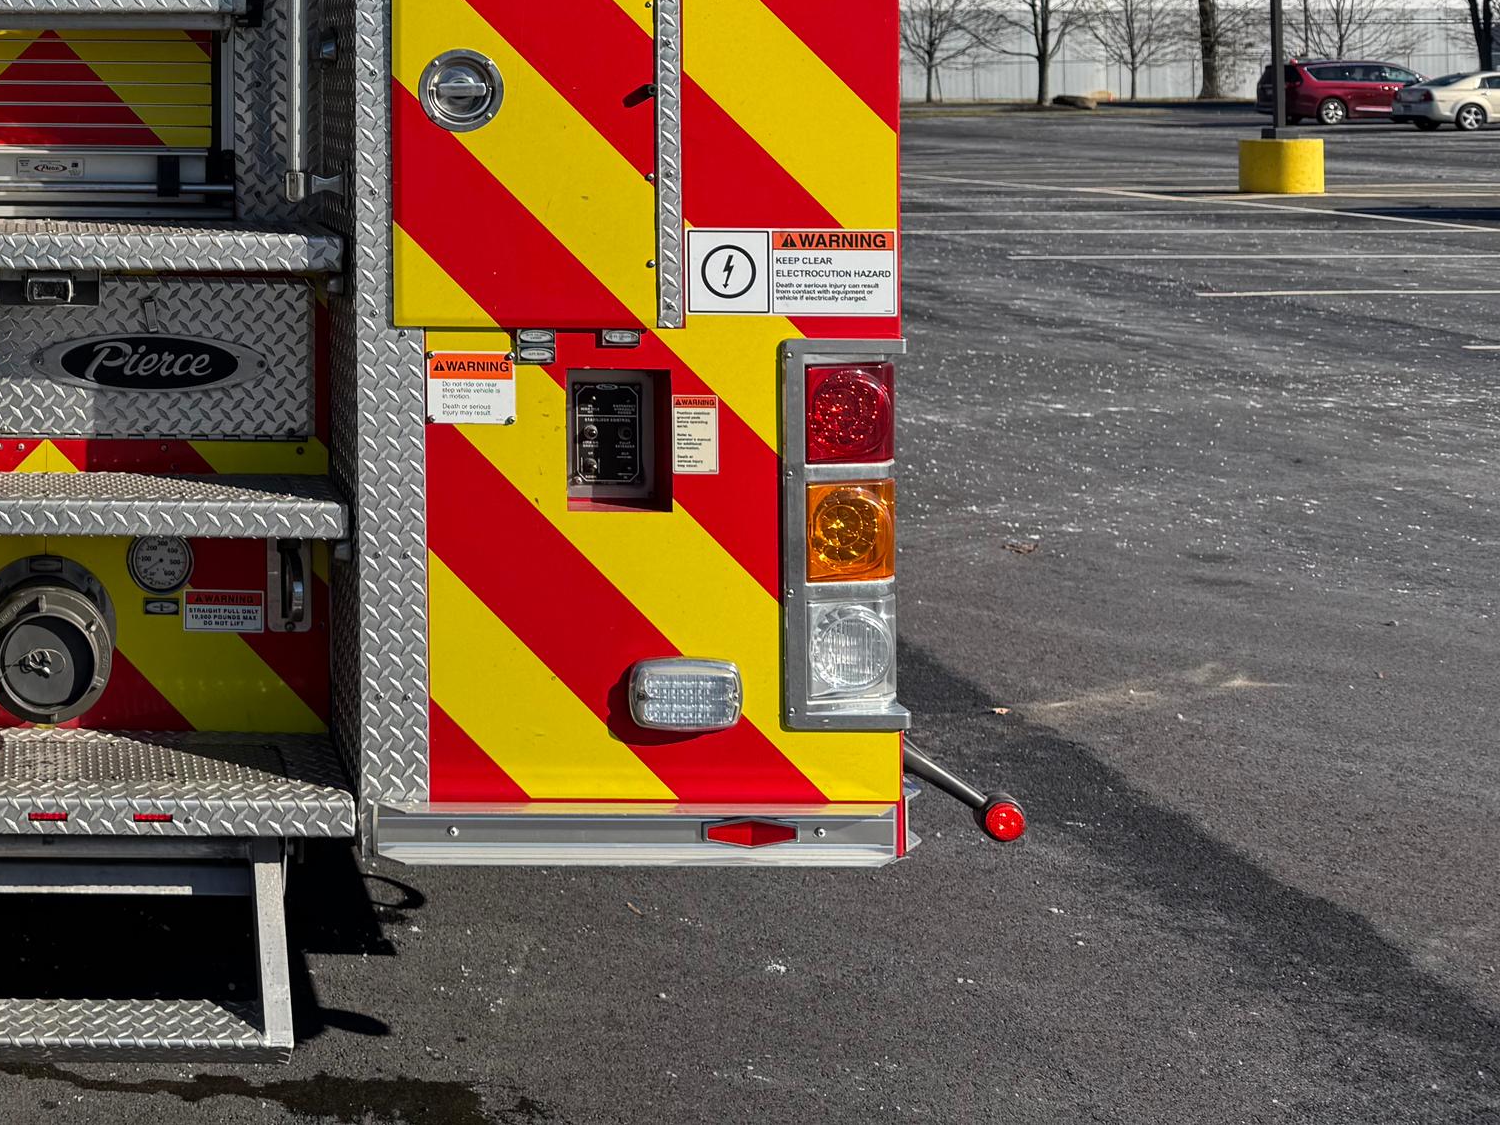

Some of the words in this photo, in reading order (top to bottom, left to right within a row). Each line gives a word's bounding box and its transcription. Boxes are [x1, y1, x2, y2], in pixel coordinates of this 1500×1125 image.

[799, 234, 886, 248] WARNING
[84, 342, 212, 381] Pierce
[446, 361, 509, 372] WARNING
